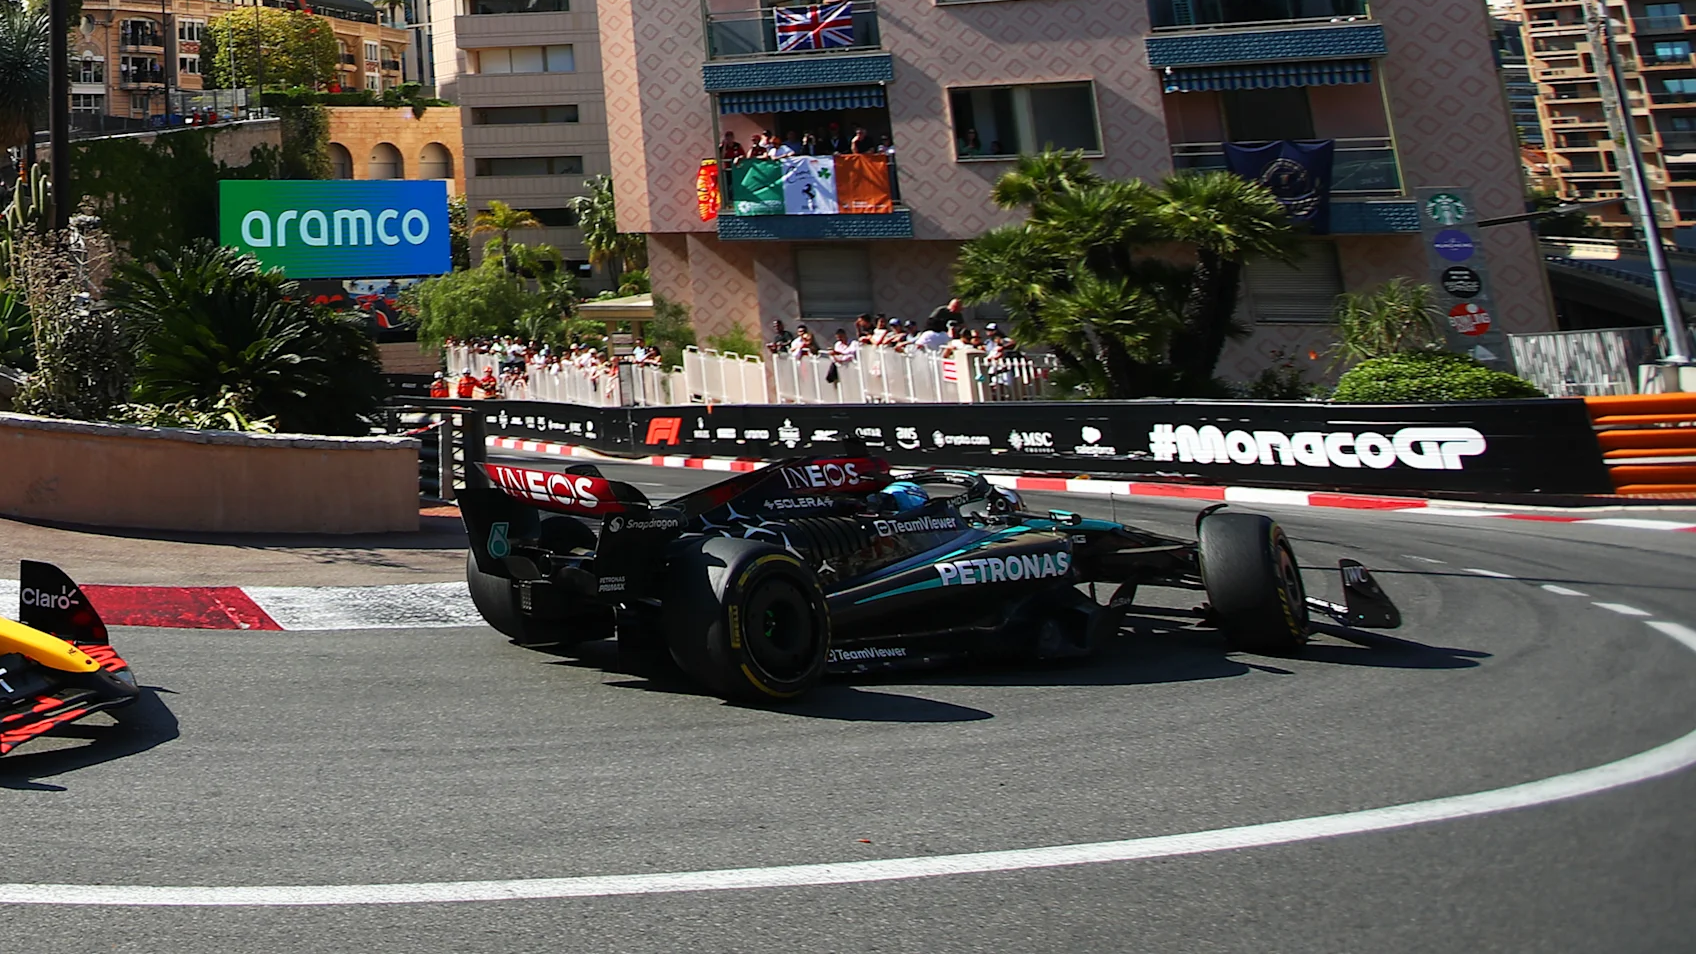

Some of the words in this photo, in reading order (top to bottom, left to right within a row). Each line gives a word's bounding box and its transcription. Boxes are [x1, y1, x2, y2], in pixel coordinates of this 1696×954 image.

[241, 208, 430, 247] aramco
[944, 434, 991, 446] crypto.com
[1021, 432, 1054, 447] MSC
[1148, 424, 1486, 470] #MonacoGP
[780, 463, 860, 489] INEOS
[495, 466, 600, 508] INEOS
[773, 496, 826, 509] SOLERA
[625, 518, 680, 531] Snapdragon
[888, 516, 957, 533] TeamViewer
[934, 551, 1070, 586] PETRONAS
[21, 587, 71, 609] Claro
[834, 646, 908, 661] TeamViewer
